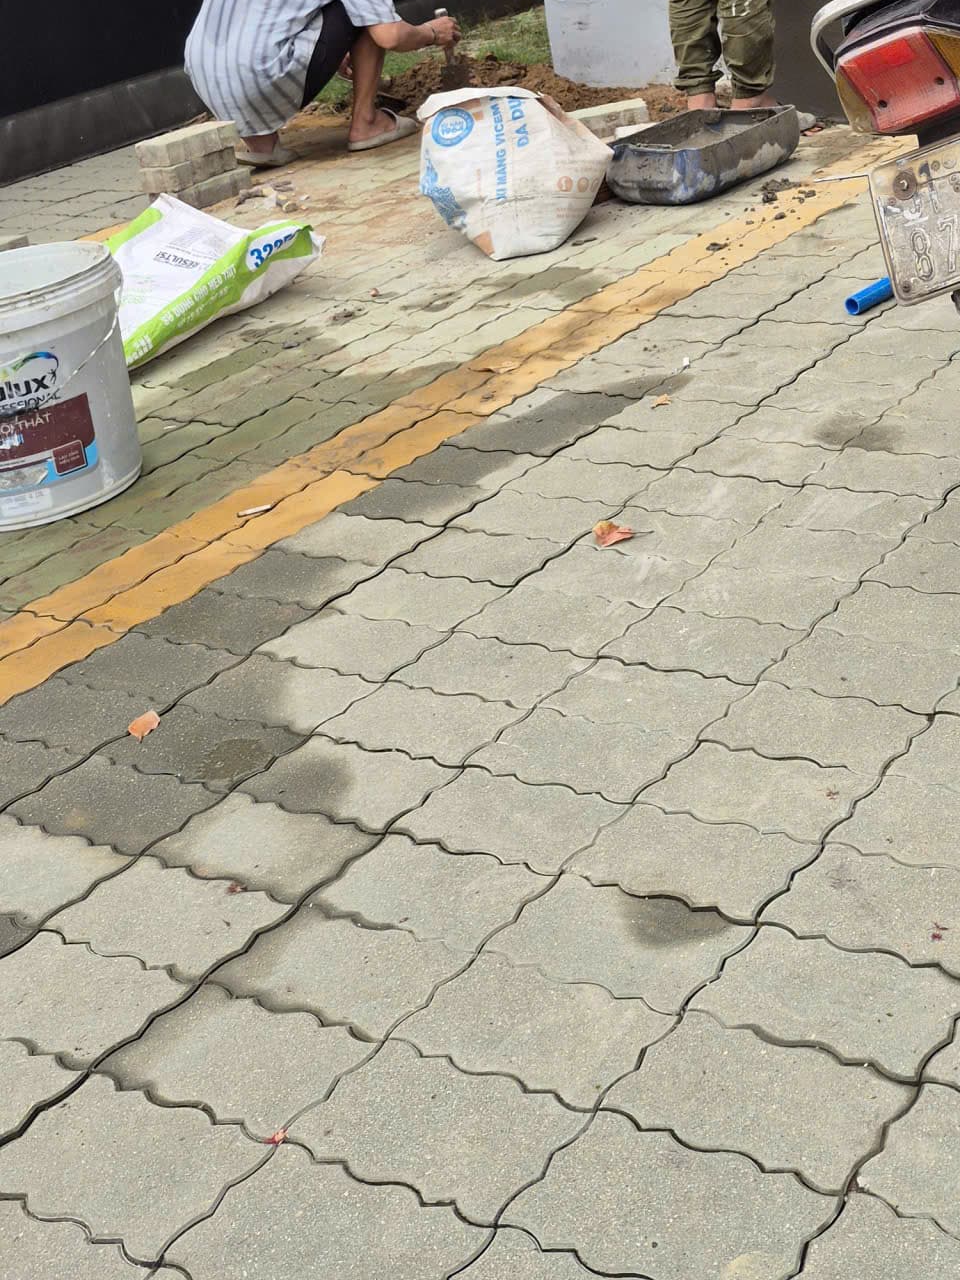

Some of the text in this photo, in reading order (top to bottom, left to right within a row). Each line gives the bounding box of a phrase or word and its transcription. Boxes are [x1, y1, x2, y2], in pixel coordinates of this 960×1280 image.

[507, 97, 525, 121] DỤ
[490, 103, 506, 146] VICEM
[0, 374, 50, 402] lux
